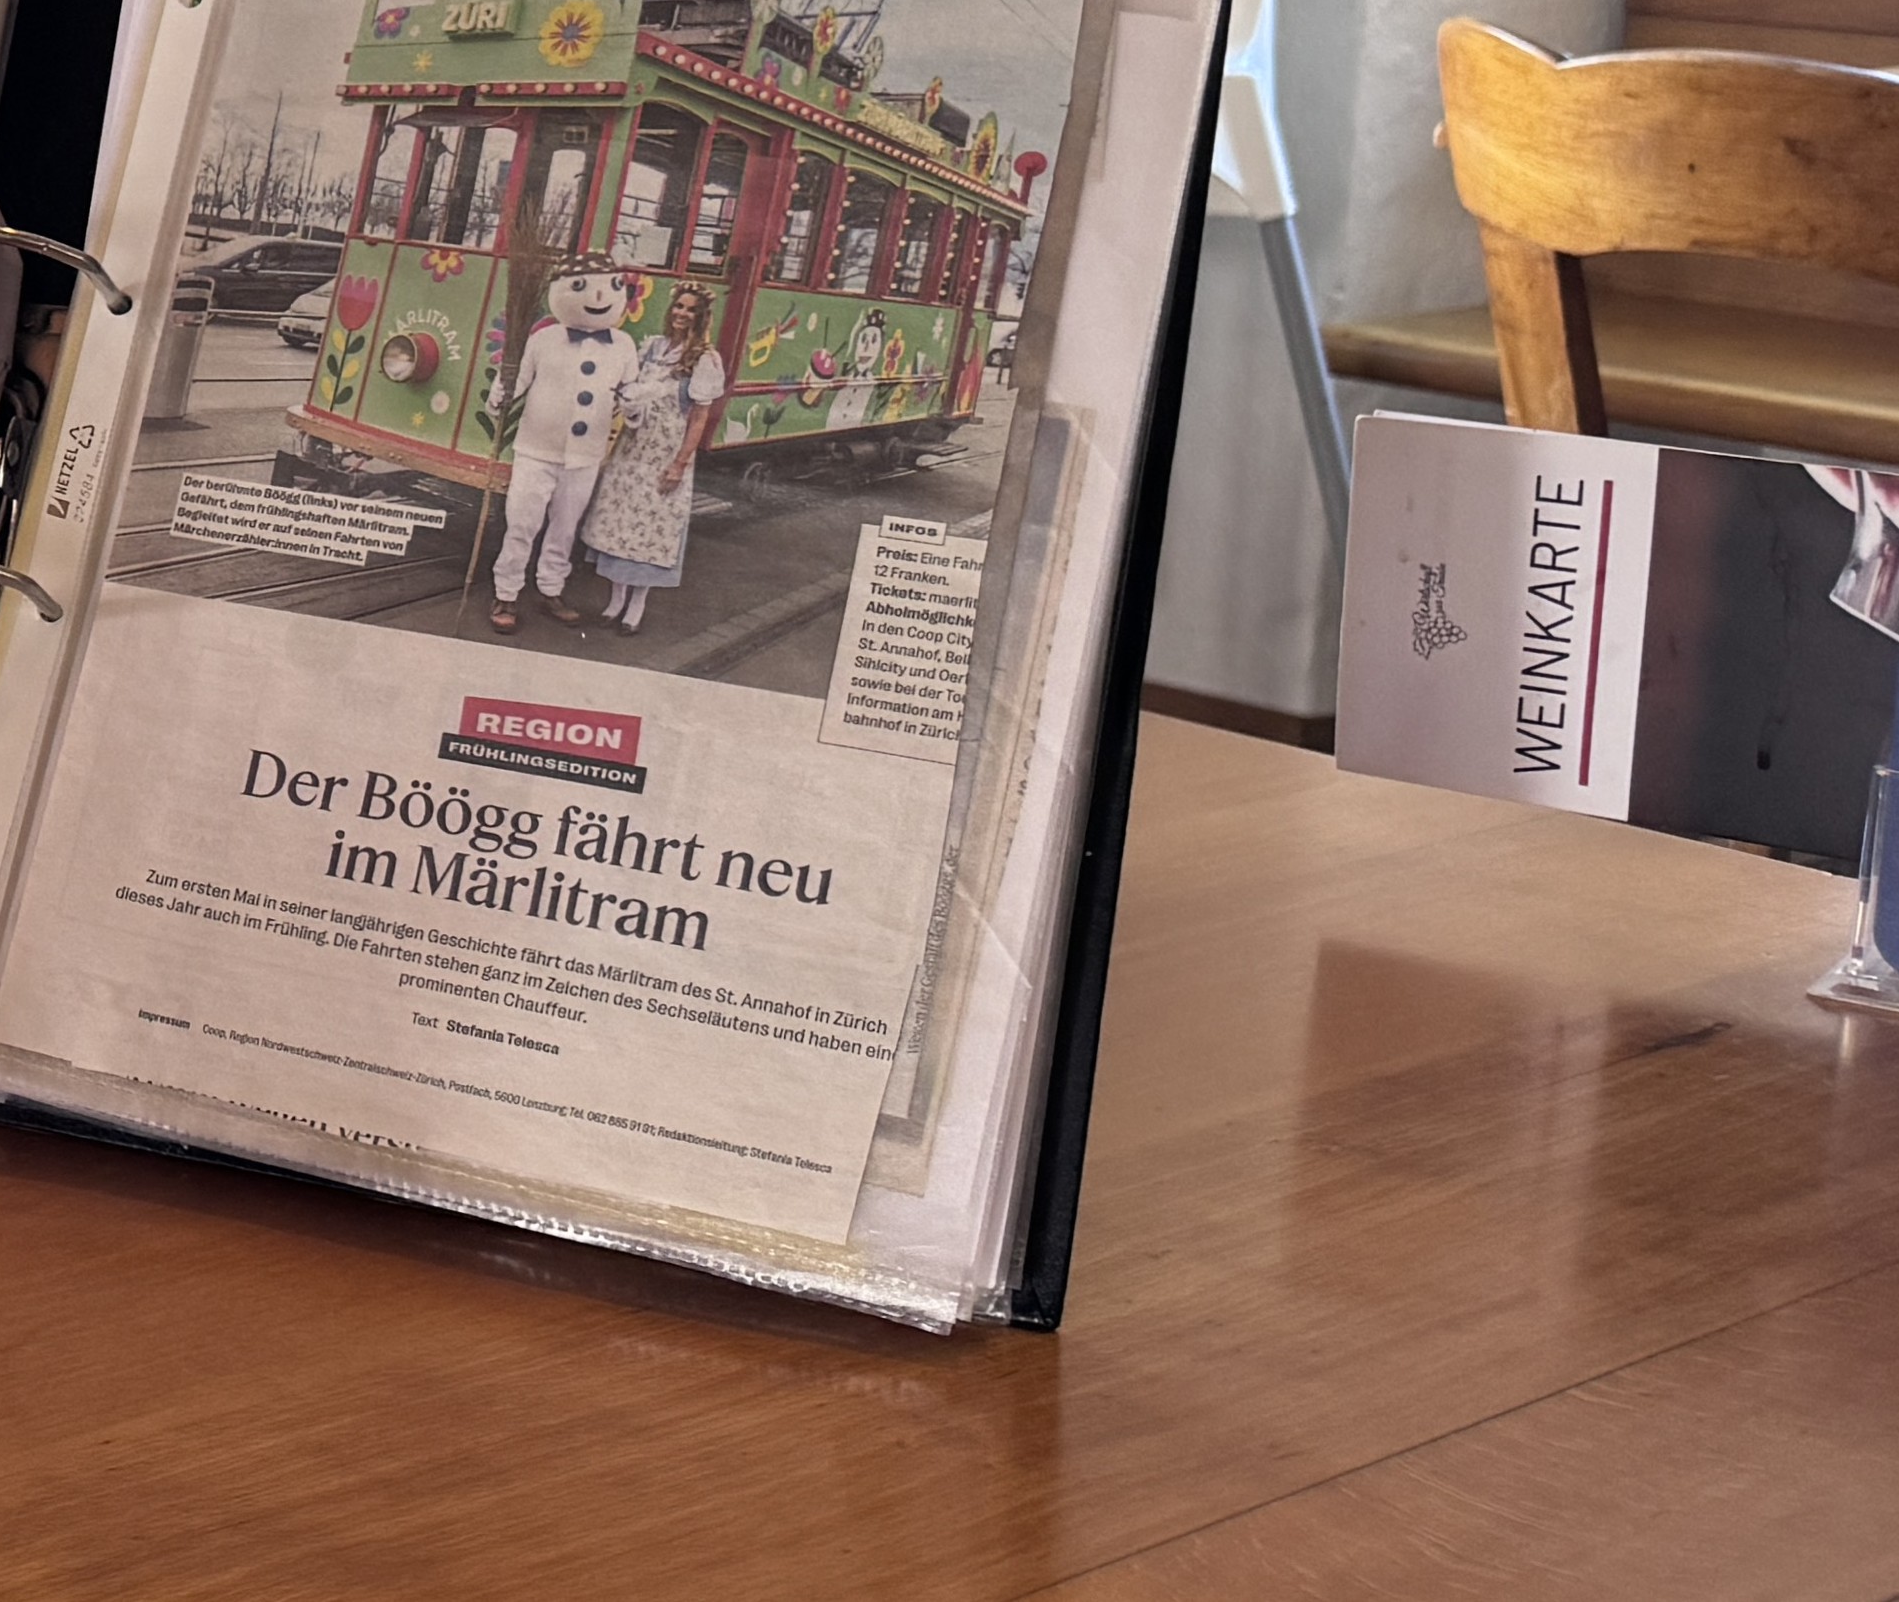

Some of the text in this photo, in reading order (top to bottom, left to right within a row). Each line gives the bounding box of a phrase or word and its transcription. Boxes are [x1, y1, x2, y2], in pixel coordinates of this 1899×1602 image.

[55, 448, 78, 495] HETZEL
[179, 491, 410, 536] Gefährt, dem frühlingshaften Märlitram.
[183, 475, 443, 524] Der berühmte Böögg (links) vor seinem neuen
[172, 522, 364, 563] Märchenerzähler:innen in Tracht.
[175, 506, 403, 552] Begleitet wird er auf seinen Fahrten von
[889, 522, 938, 537] INFOS
[874, 565, 949, 586] 12 Franken.
[877, 546, 918, 562] Preis:
[921, 552, 950, 567] Eine
[871, 582, 926, 601] Tickets:
[862, 620, 973, 648] In den Coop City
[1513, 474, 1584, 773] WEINKARTE
[855, 656, 907, 676] Sihlcity
[909, 665, 936, 679] und
[859, 638, 876, 651] St.
[880, 641, 941, 662] Annahof,
[847, 693, 929, 717] Information
[932, 709, 953, 719] am
[851, 676, 891, 691] sowie
[895, 682, 916, 694] bei
[919, 685, 943, 698] der
[477, 713, 622, 749] REGION
[843, 711, 902, 733] bahnhof
[905, 719, 916, 733] in
[449, 742, 636, 784] FRÜHLINGSEDITION
[241, 750, 832, 904] Der Böögg fährt neu
[325, 830, 708, 950] im Märlitram
[116, 886, 164, 908] dieses
[167, 898, 201, 915] Jahr
[203, 908, 240, 924] auch
[243, 914, 262, 929] im
[265, 918, 329, 946] Frühling.
[333, 933, 358, 950] Die
[361, 938, 422, 964] Fahrten
[425, 954, 479, 975] stehen
[481, 965, 520, 984] ganz
[523, 973, 542, 989] im
[545, 977, 609, 1003] Zeichen
[613, 993, 642, 1010] des
[647, 998, 769, 1036] Sechseläutens
[774, 1027, 805, 1043] und
[809, 1031, 861, 1055] haben
[146, 869, 178, 888] Zum
[182, 880, 230, 900] ersten
[233, 888, 261, 906] Mal
[263, 895, 277, 910] in
[279, 901, 328, 920] seiner
[330, 909, 424, 940] langjährigen
[428, 929, 517, 959] Geschichte
[521, 948, 562, 969] fährt
[565, 958, 594, 975] das
[598, 964, 678, 992] Märlitram
[682, 982, 712, 1000] des
[715, 988, 737, 1005] St.
[741, 993, 812, 1019] Annahof
[815, 1007, 830, 1023] in
[833, 1011, 887, 1035] Zürich
[399, 973, 587, 1023] prominenten Chauffeur.
[413, 1012, 559, 1055] Text Stefania Telesca
[137, 1008, 191, 1031] Impressum
[201, 1023, 229, 1040] Coop,
[228, 1029, 261, 1048] Region
[447, 1079, 494, 1100] Postfach,
[748, 1146, 794, 1166] Stefania
[793, 1156, 833, 1175] Telesca
